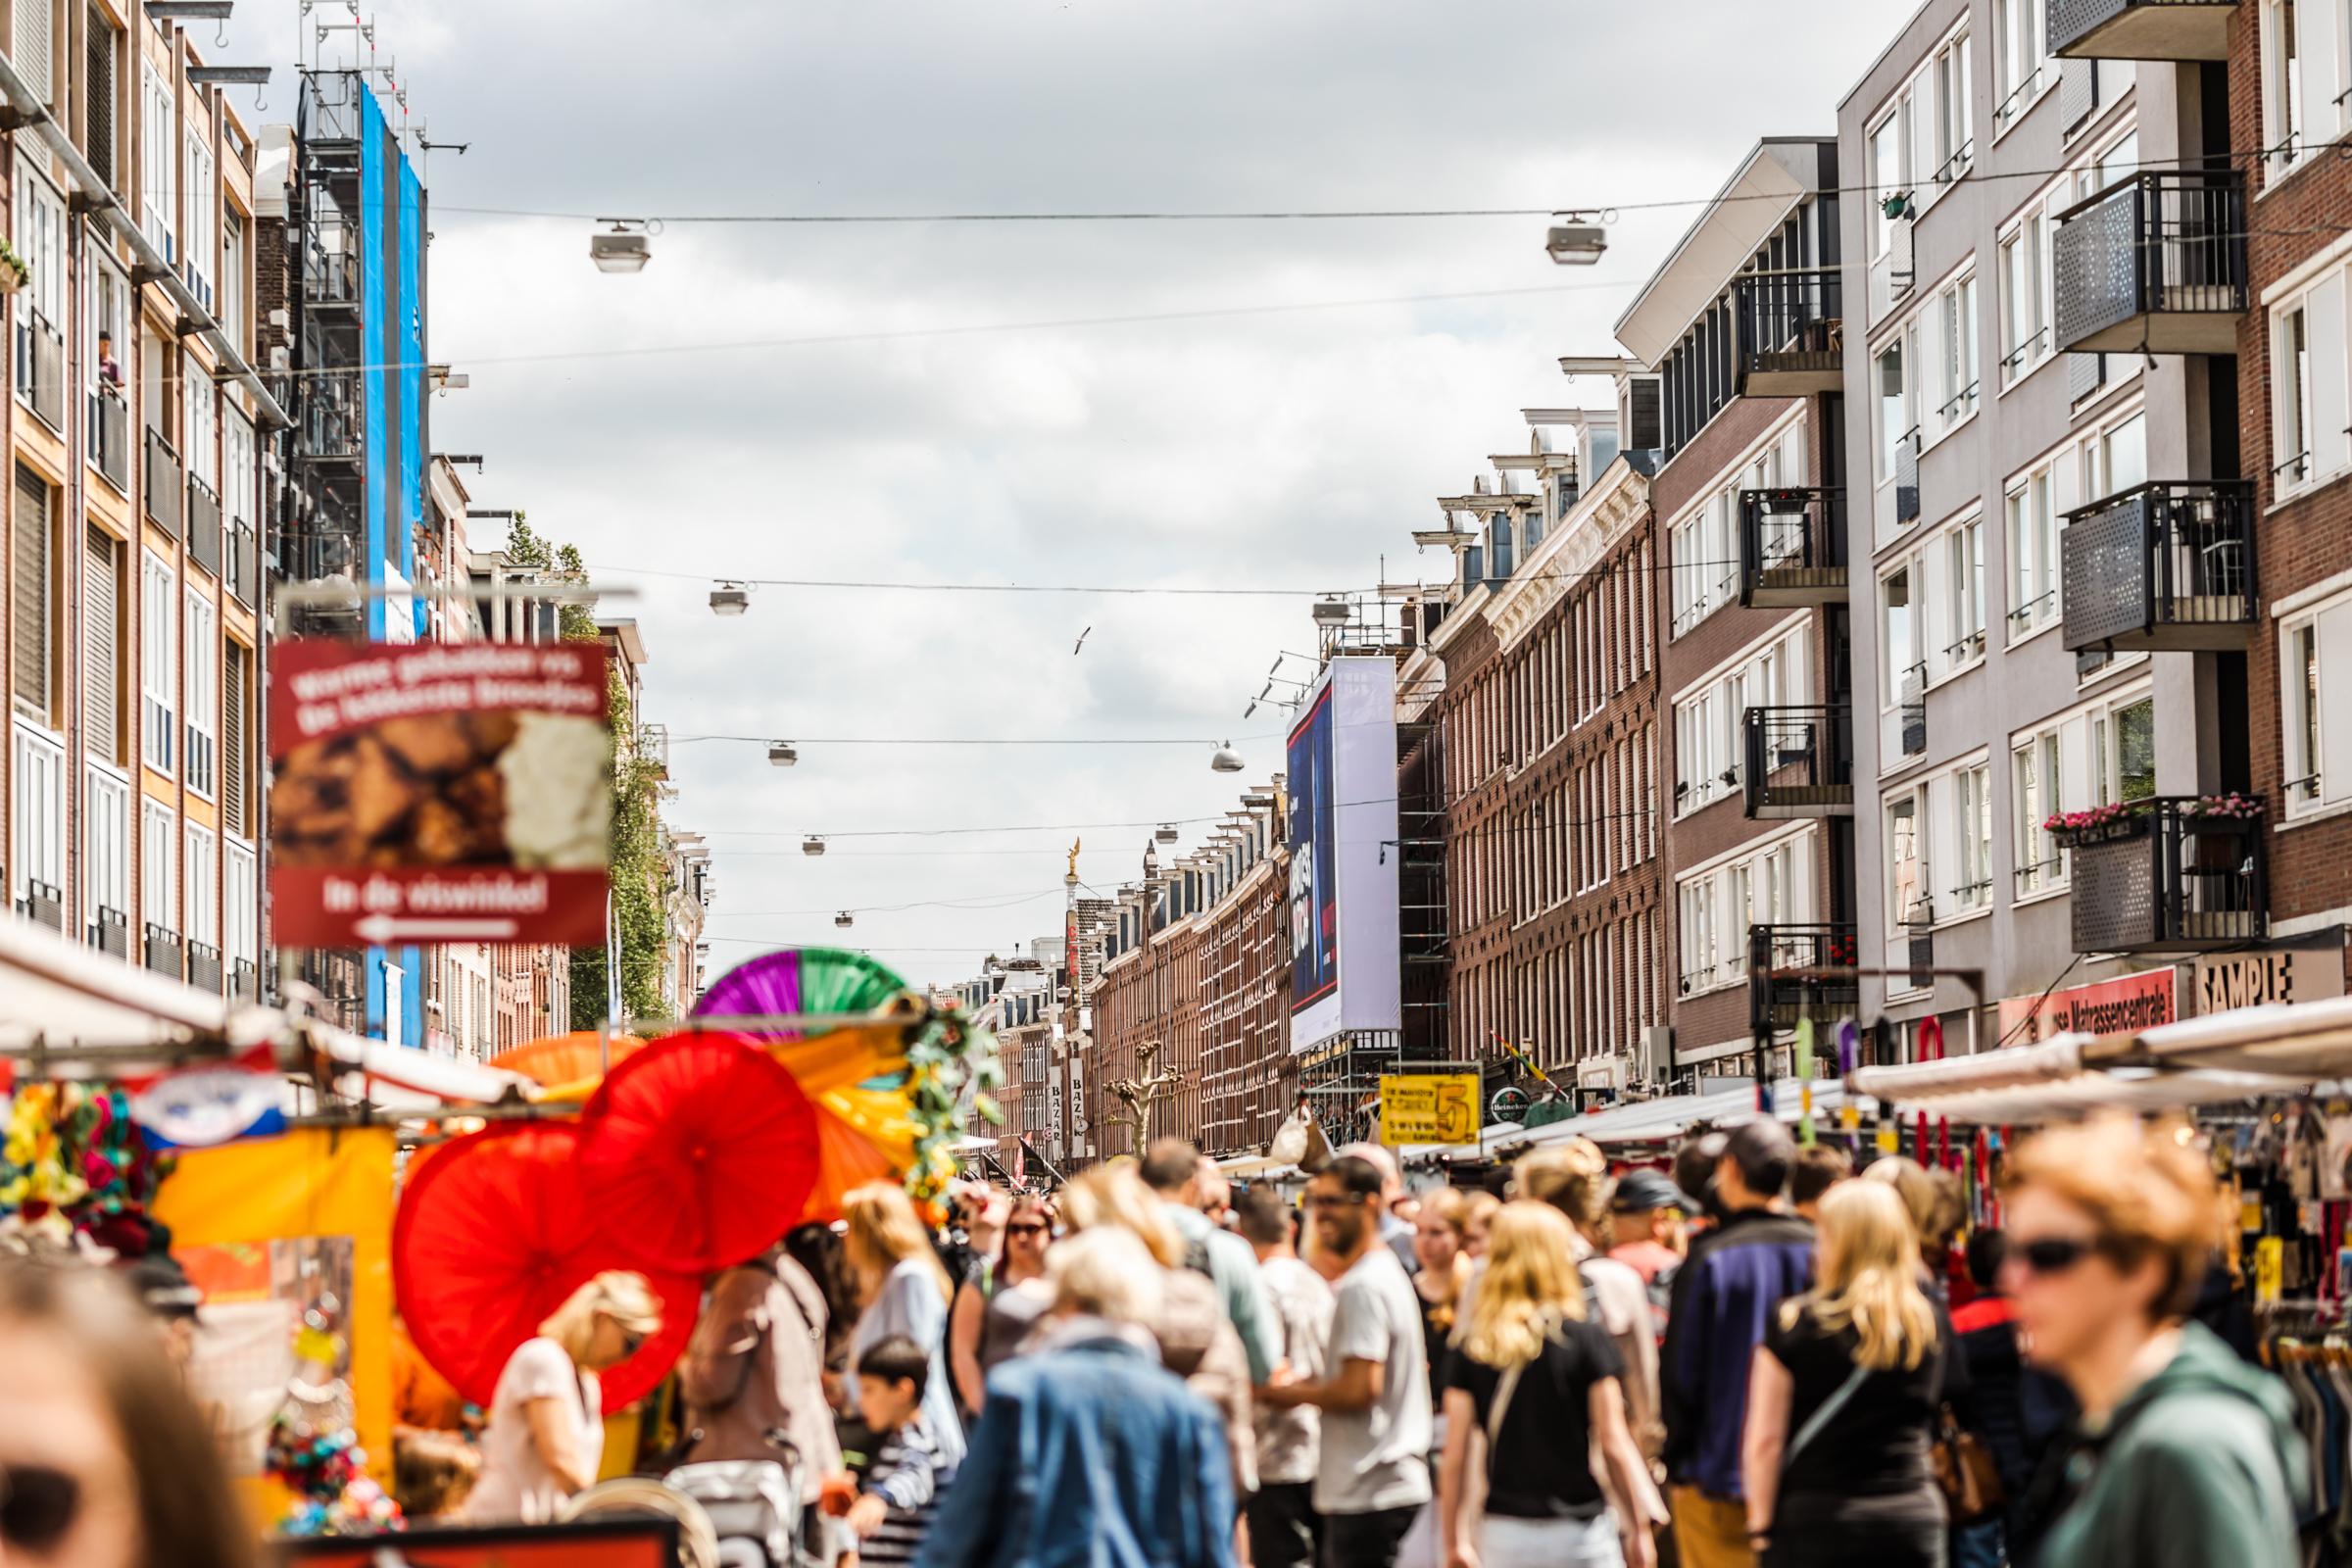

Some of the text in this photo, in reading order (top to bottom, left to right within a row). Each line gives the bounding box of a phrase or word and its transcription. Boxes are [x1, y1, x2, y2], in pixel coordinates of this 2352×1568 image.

[2071, 984, 2166, 1035] Matrassencentrale
[2200, 954, 2291, 1013] SAMPLE
[1052, 1086, 1060, 1141] BAZAR
[1435, 1083, 1470, 1143] 5
[1494, 1102, 1529, 1111] Heineken
